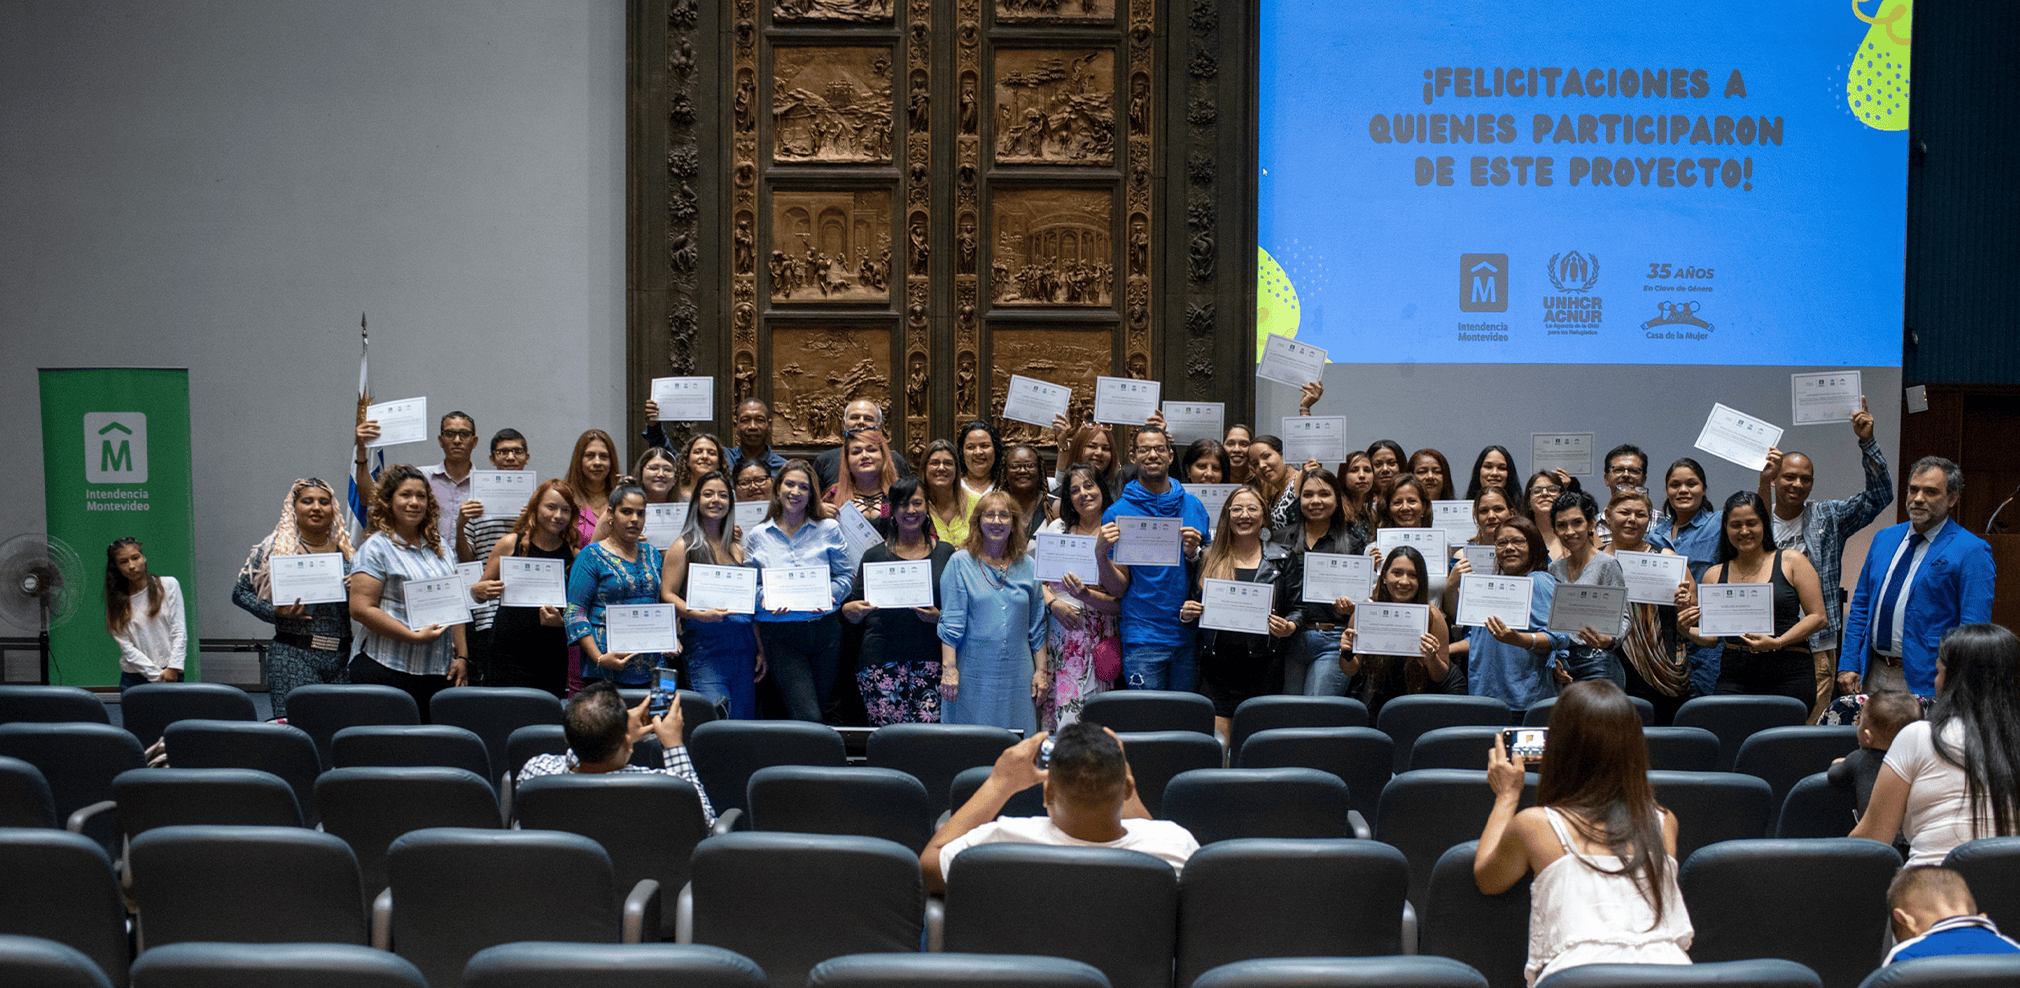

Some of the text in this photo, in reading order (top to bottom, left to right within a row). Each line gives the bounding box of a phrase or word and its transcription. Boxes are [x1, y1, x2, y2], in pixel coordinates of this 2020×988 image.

[1423, 67, 1747, 104] ¡FELICITACIONES A
[1369, 114, 1783, 146] QUIENES PARTICIPARON
[1415, 156, 1753, 192] DE ESTE PROYECTO!
[1646, 263, 1715, 279] 35 AÑOS
[1543, 296, 1603, 309] UNHCR
[1543, 309, 1603, 323] ACNUR
[1457, 321, 1509, 331] Intendencia
[1457, 332, 1509, 341] Montevideo
[1646, 331, 1709, 341] Casa de la Mujer
[101, 439, 133, 472] M
[86, 489, 149, 499] Intendencia
[86, 501, 150, 511] Montevideo
